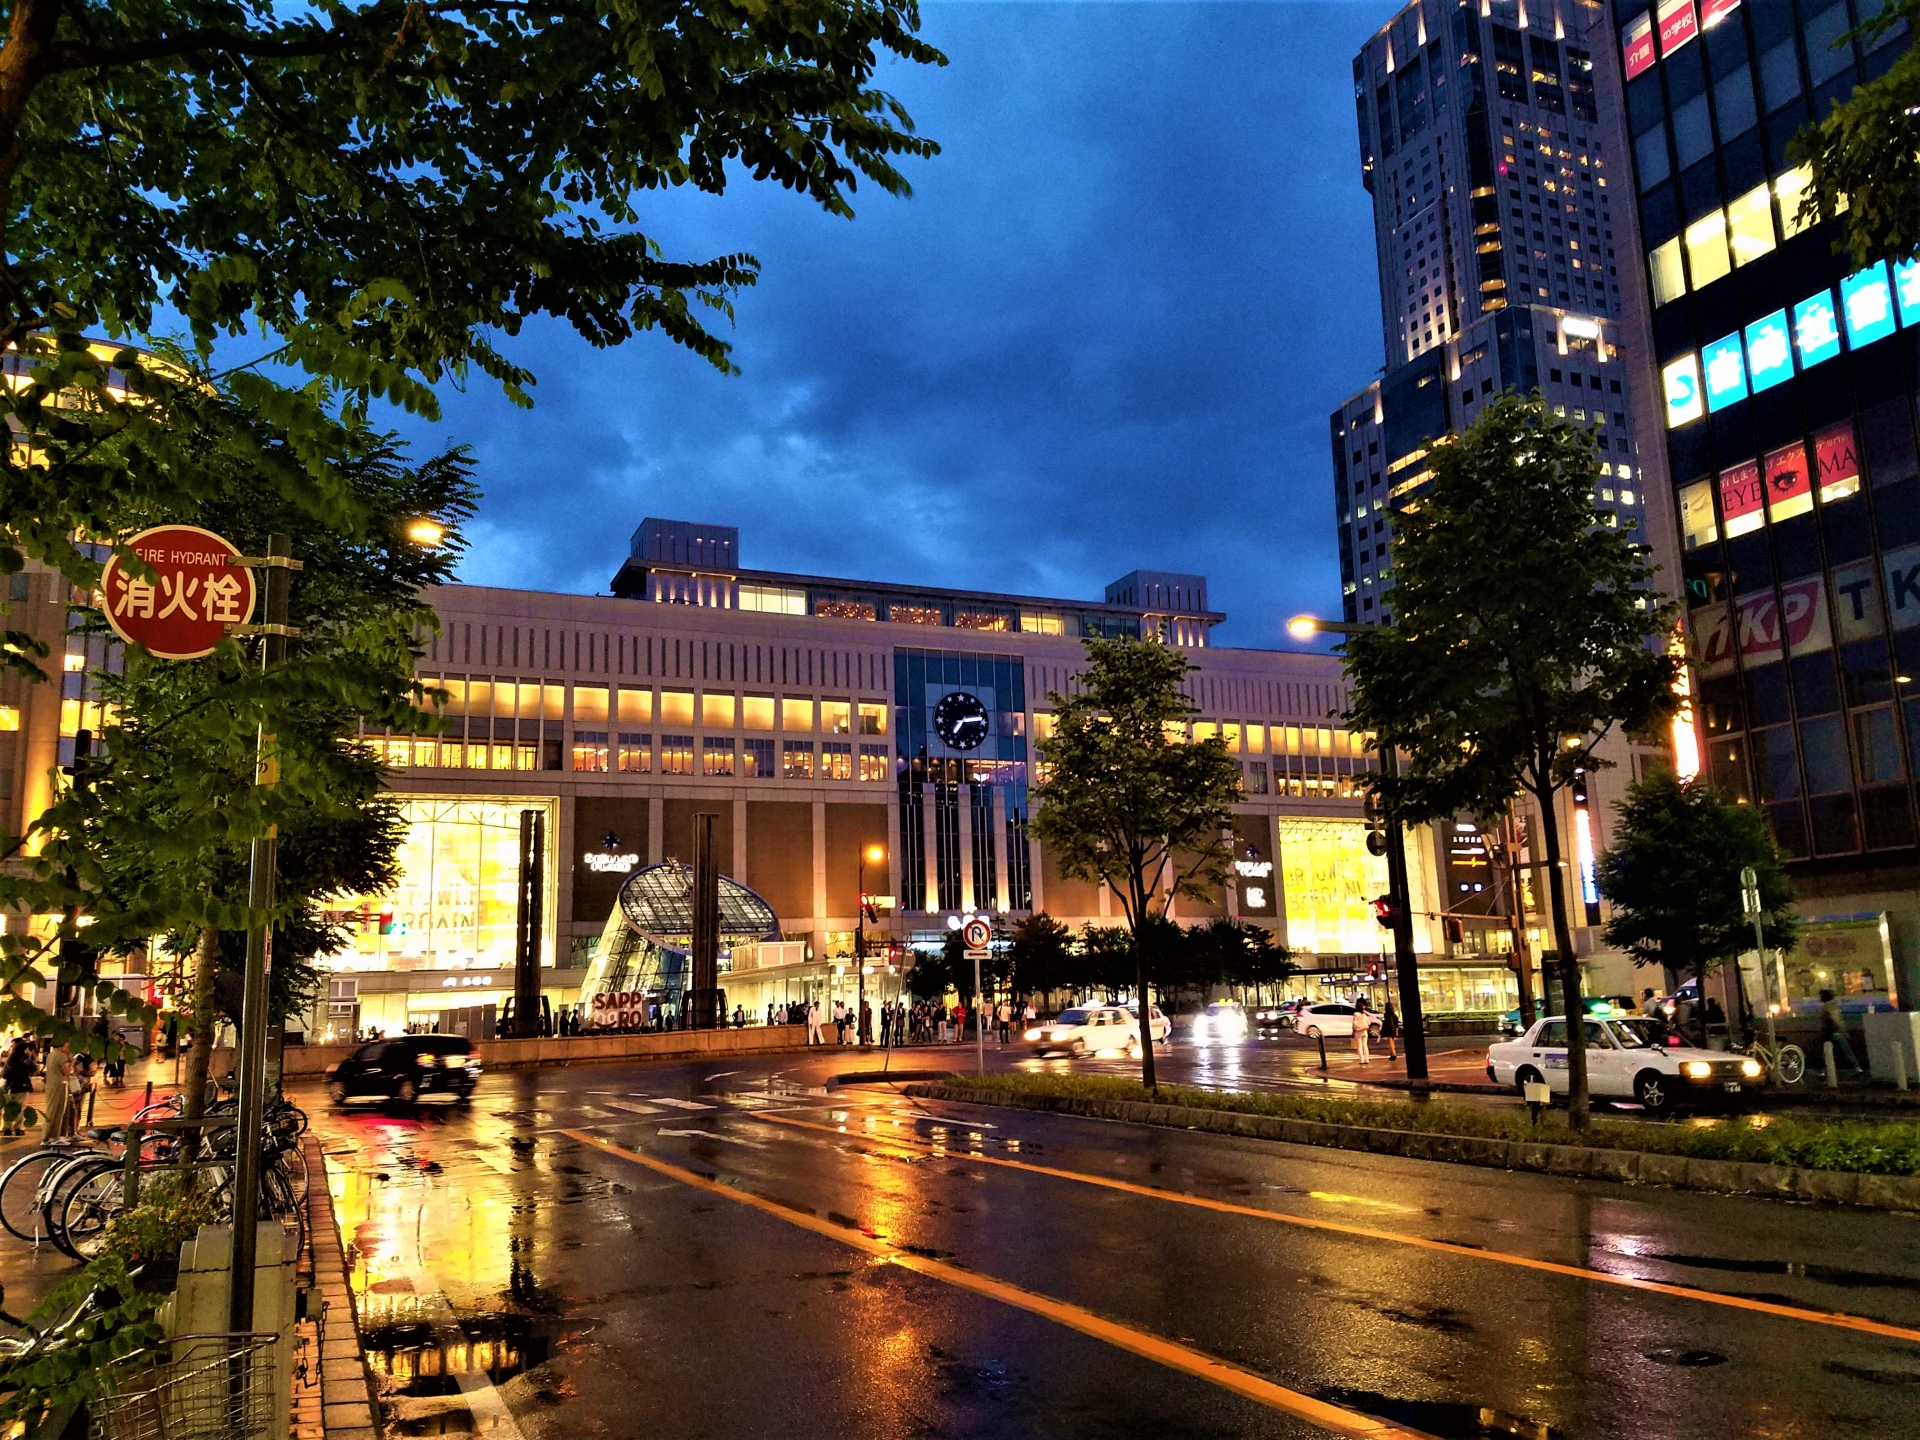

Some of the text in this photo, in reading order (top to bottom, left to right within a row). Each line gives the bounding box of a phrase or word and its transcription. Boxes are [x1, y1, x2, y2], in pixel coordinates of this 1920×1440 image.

[171, 551, 227, 566] HYDRANT
[114, 571, 242, 622] 消火栓
[593, 992, 642, 1009] SAPP
